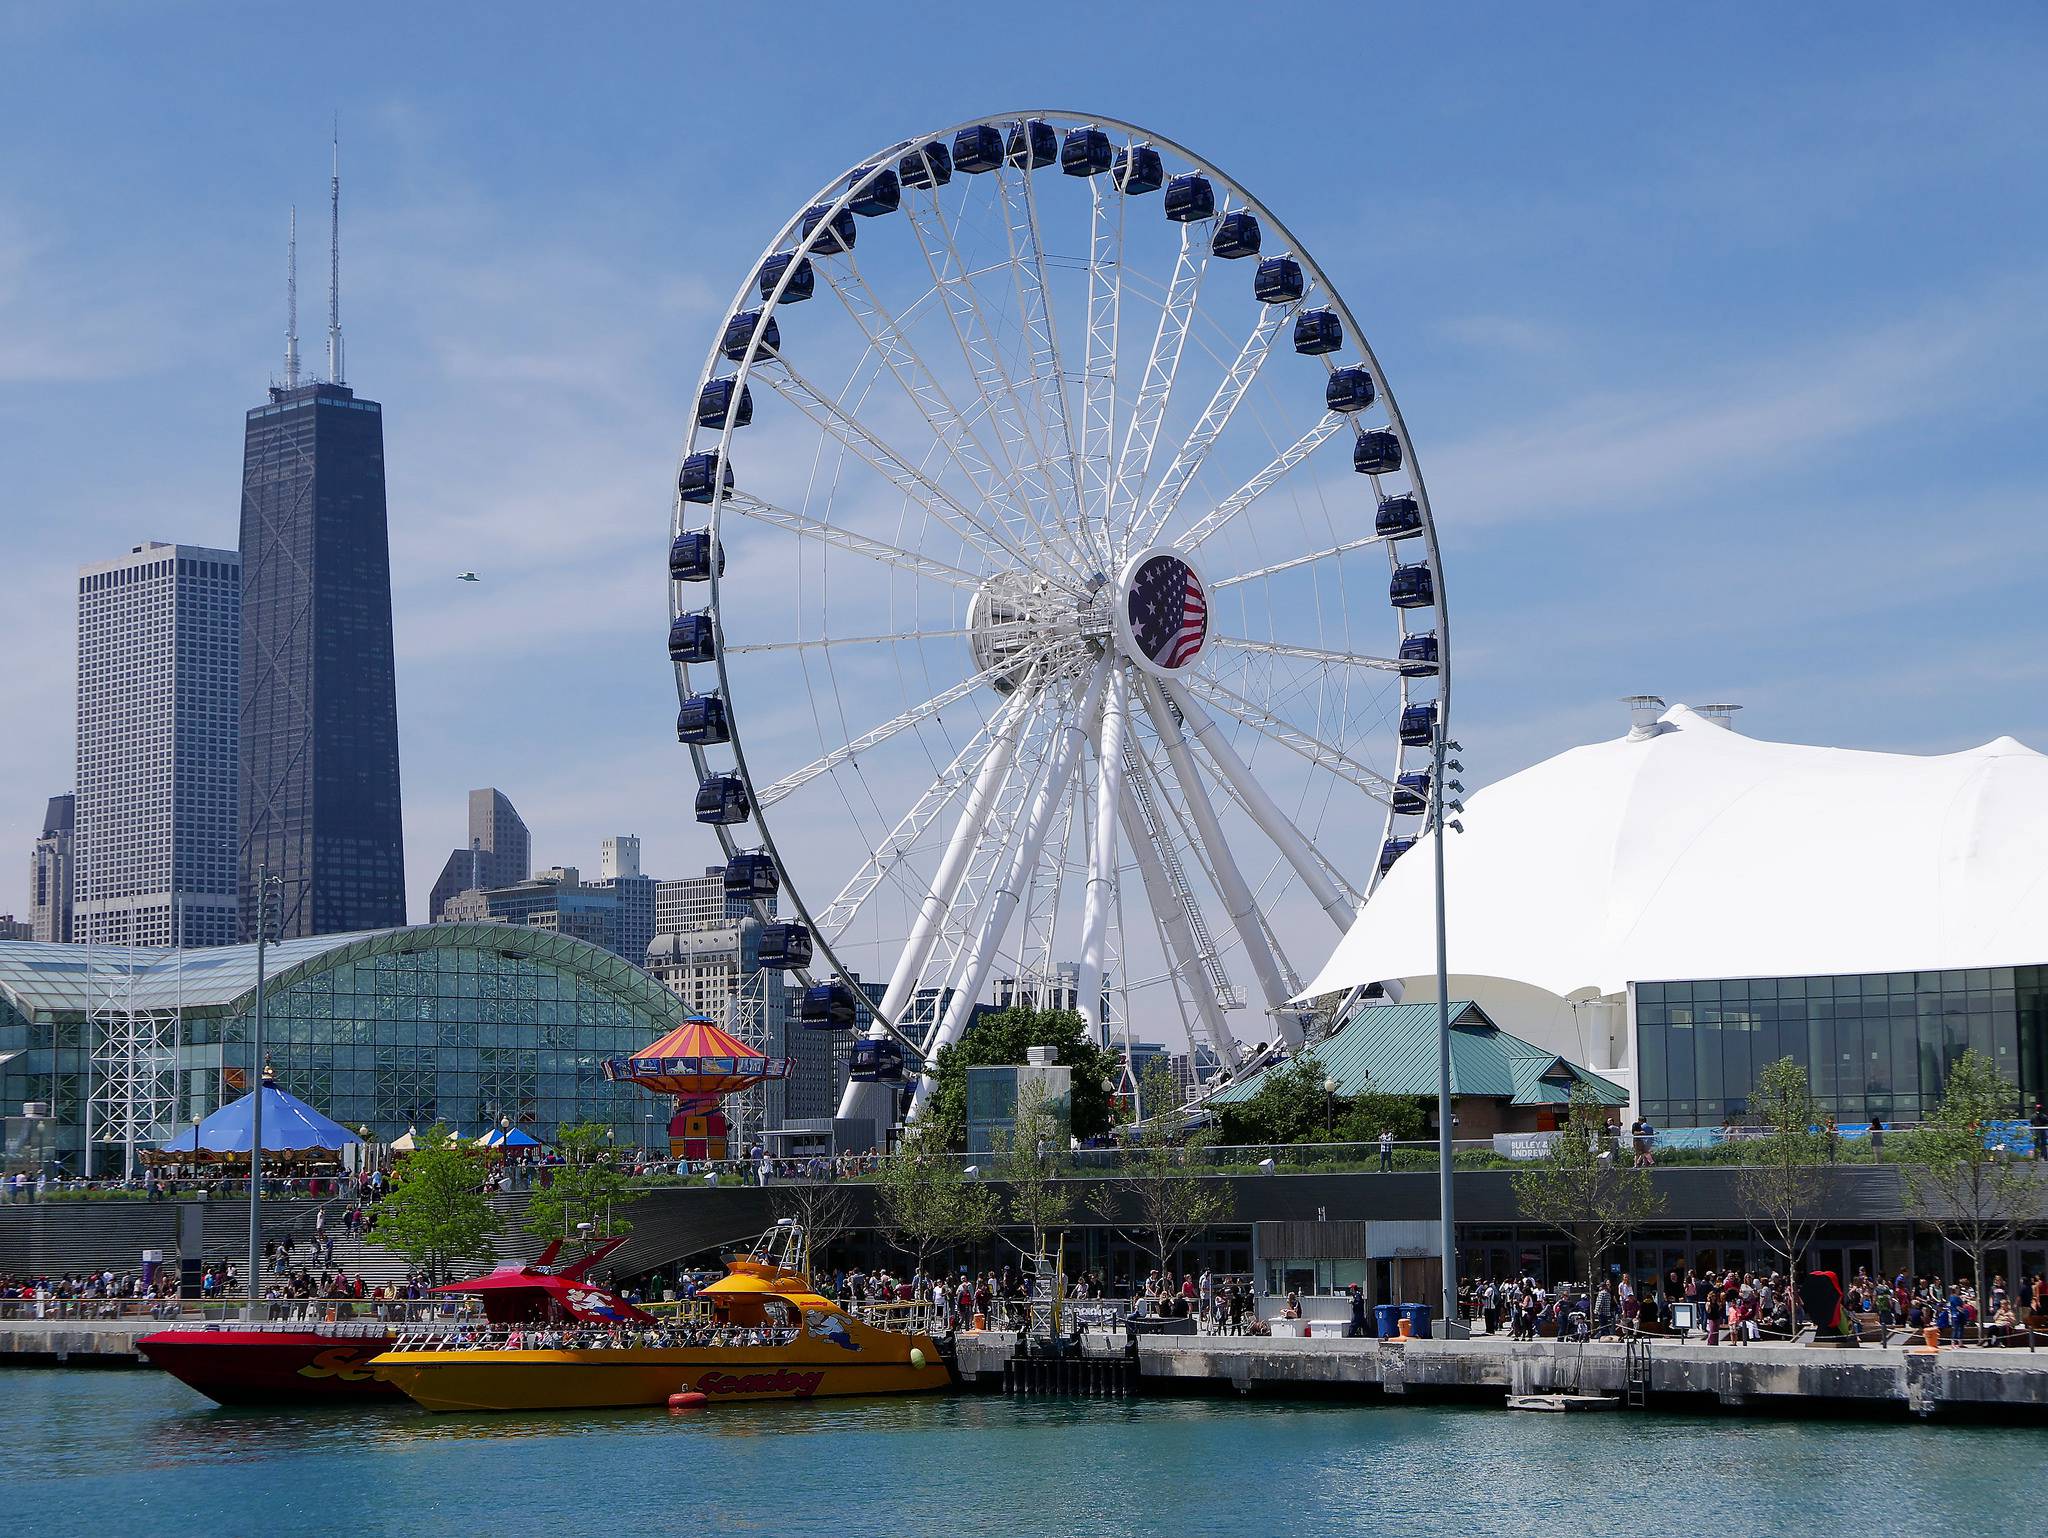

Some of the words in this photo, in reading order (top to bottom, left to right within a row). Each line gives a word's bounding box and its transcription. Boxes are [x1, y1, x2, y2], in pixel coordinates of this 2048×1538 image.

[1511, 1141, 1541, 1149] BULLEY
[1541, 1141, 1548, 1149] &
[693, 1369, 825, 1397] Seadog
